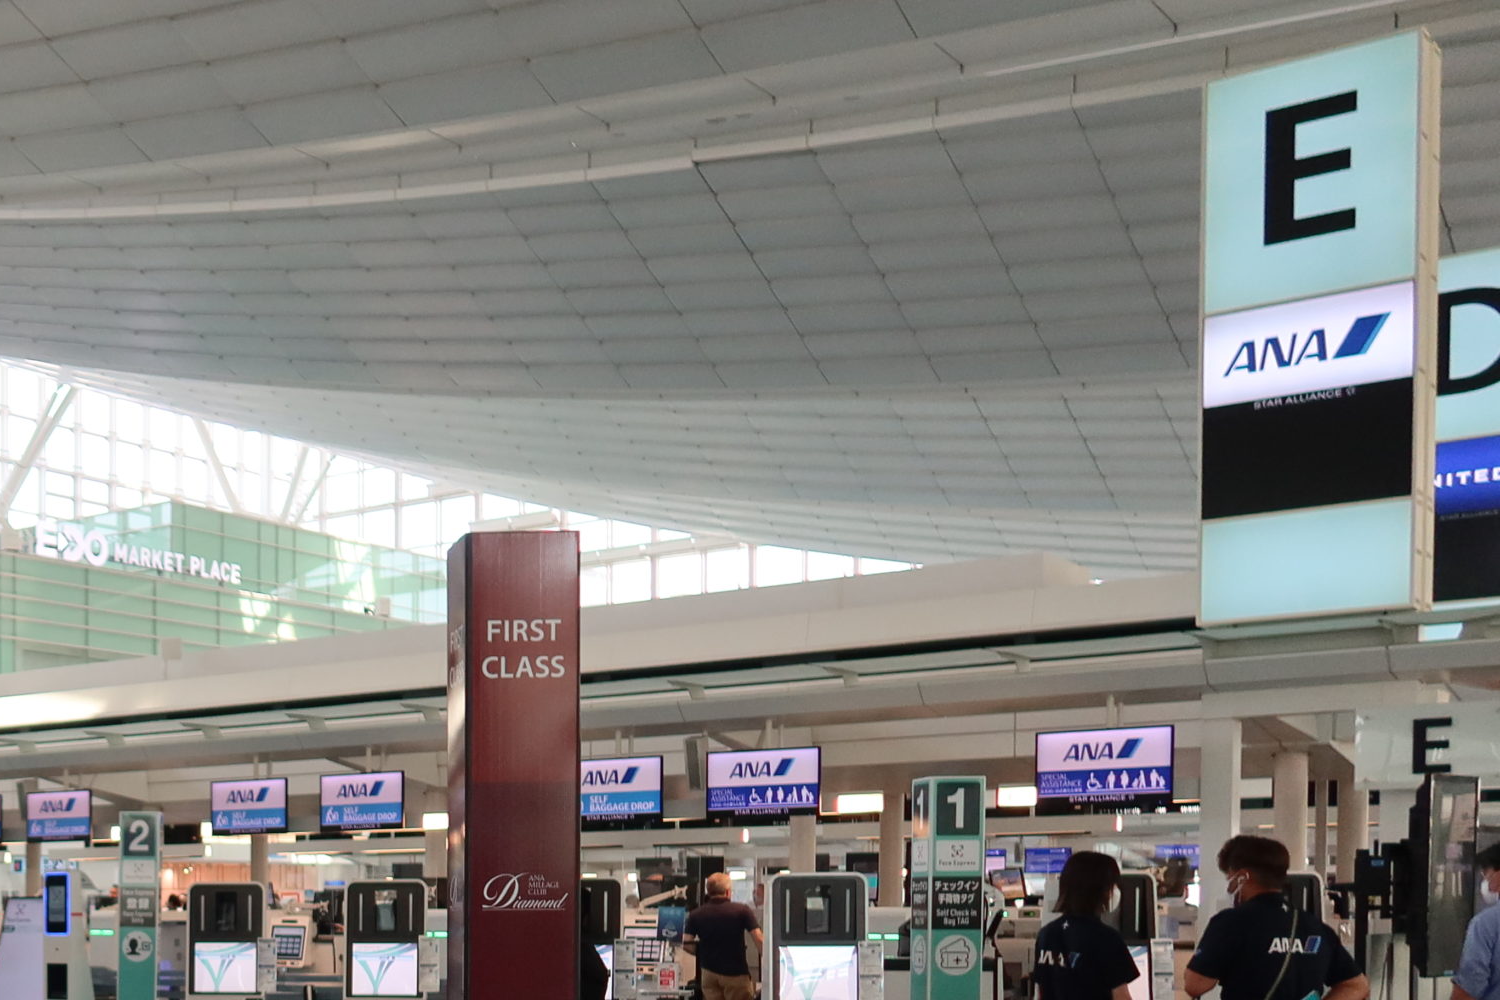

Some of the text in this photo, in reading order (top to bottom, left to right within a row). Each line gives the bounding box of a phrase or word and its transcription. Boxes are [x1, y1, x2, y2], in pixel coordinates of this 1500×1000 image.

[1263, 89, 1358, 246] E
[1436, 286, 1500, 397] D
[1224, 328, 1328, 377] ANA
[1253, 389, 1342, 411] STAR ALLIANCE
[35, 521, 242, 585] EDO MARKET PLACE
[486, 618, 562, 642] FIRST
[481, 655, 566, 679] CLASS
[1062, 741, 1115, 762] ANA
[1412, 716, 1453, 774] E
[582, 769, 619, 786] ANA
[729, 761, 772, 779] ANA
[226, 788, 254, 803] ANA
[336, 784, 368, 797] ANA
[590, 795, 608, 803] SELF
[39, 801, 63, 813] ANA
[377, 811, 397, 820] DROP
[590, 801, 655, 811] BAGGAGE DROP
[947, 788, 964, 829] 1
[128, 819, 149, 851] 2
[529, 874, 545, 882] ANA
[934, 880, 979, 891] チェックイン
[482, 872, 569, 910] Diamond
